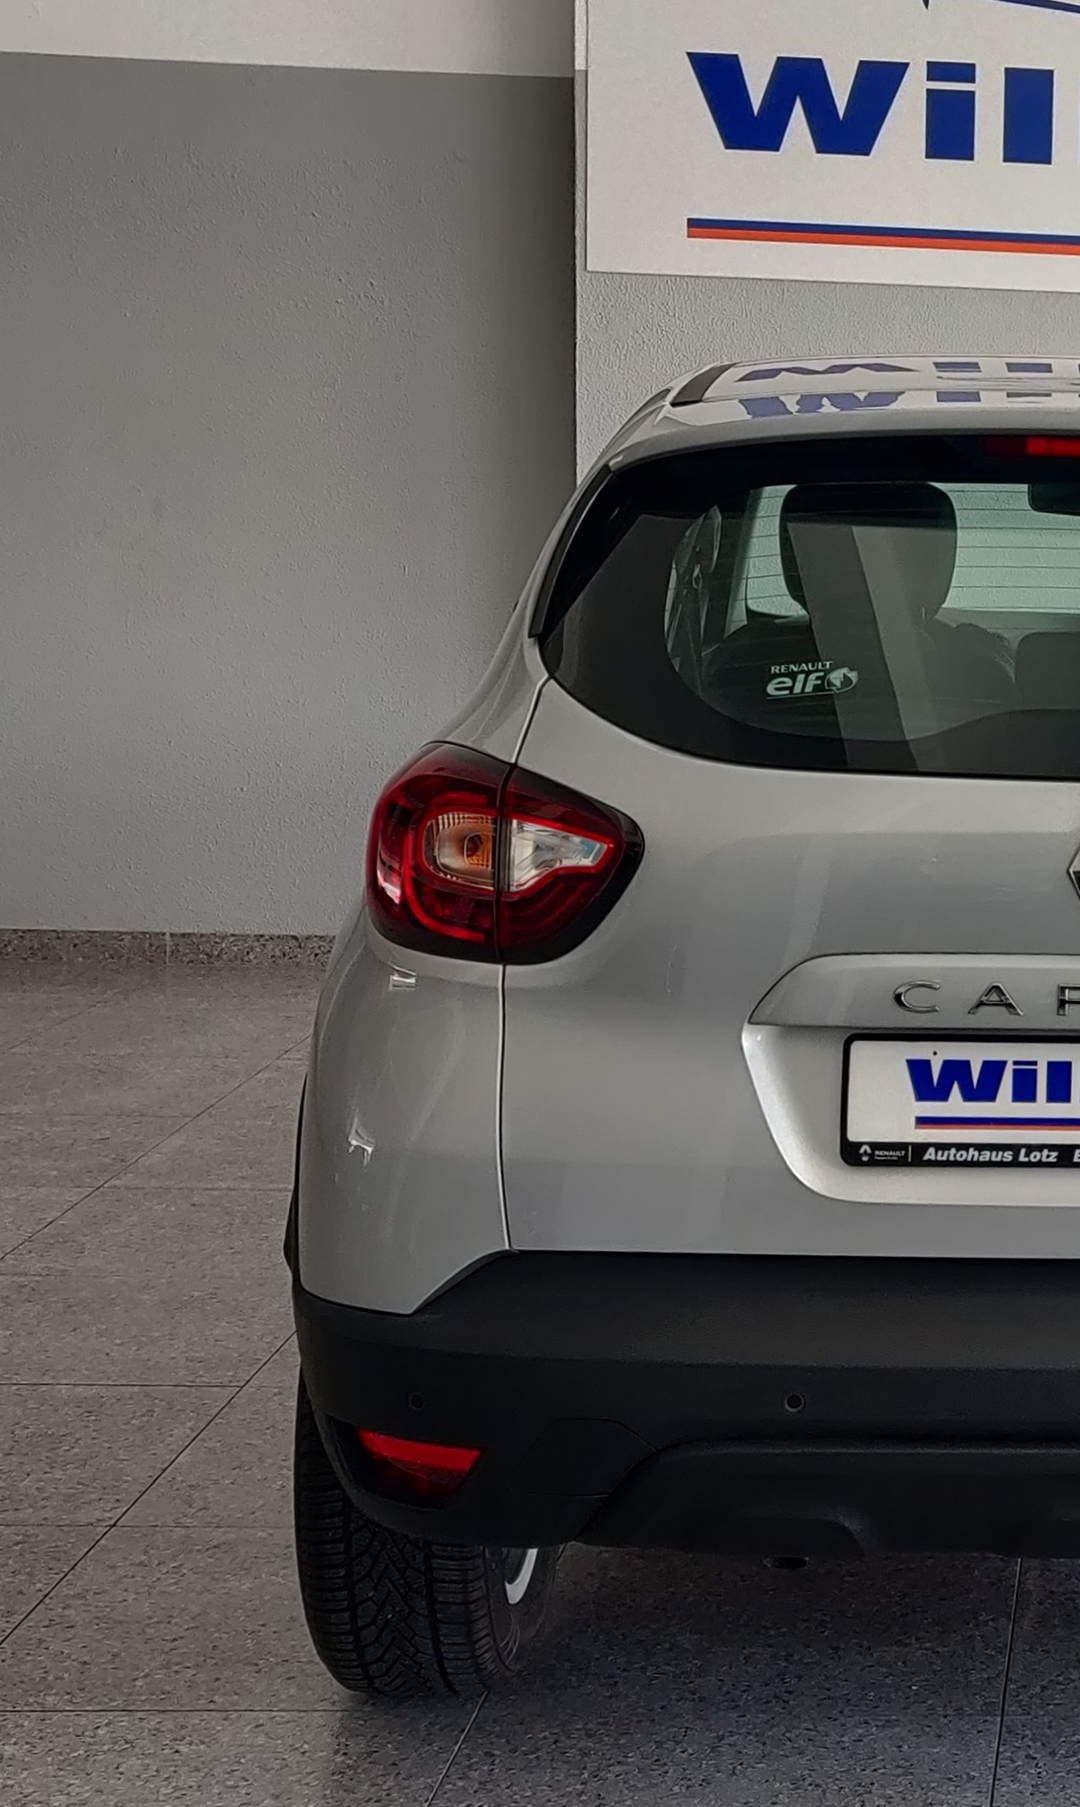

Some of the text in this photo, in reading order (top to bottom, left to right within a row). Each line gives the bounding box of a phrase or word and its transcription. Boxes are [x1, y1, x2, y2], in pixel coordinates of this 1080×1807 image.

[770, 661, 834, 674] RENAULT
[766, 672, 825, 695] elf
[922, 1146, 1013, 1162] Autohaus
[1018, 1147, 1058, 1162] Lotz
